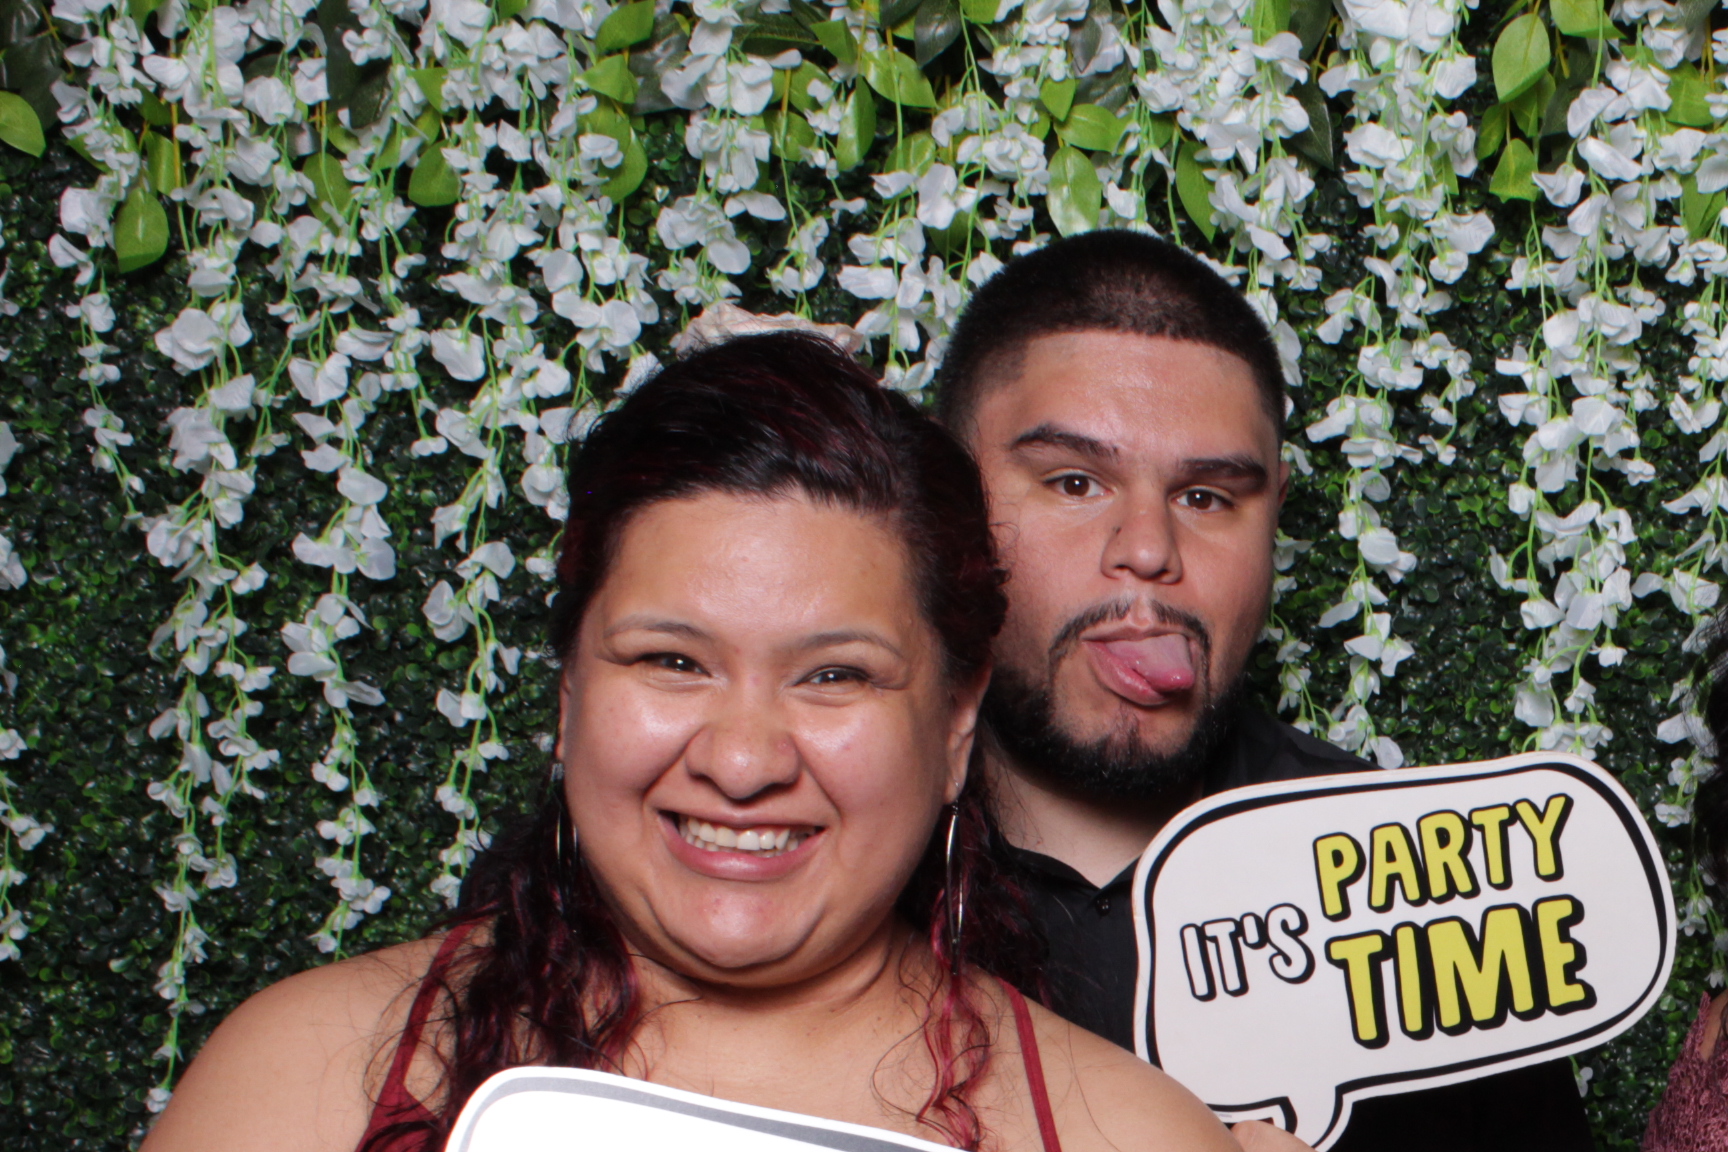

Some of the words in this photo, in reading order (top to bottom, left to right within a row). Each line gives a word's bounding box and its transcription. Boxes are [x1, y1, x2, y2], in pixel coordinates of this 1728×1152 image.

[1313, 793, 1574, 922] PARTY
[1180, 903, 1316, 1002] IT'S
[1325, 894, 1598, 1049] TIME
